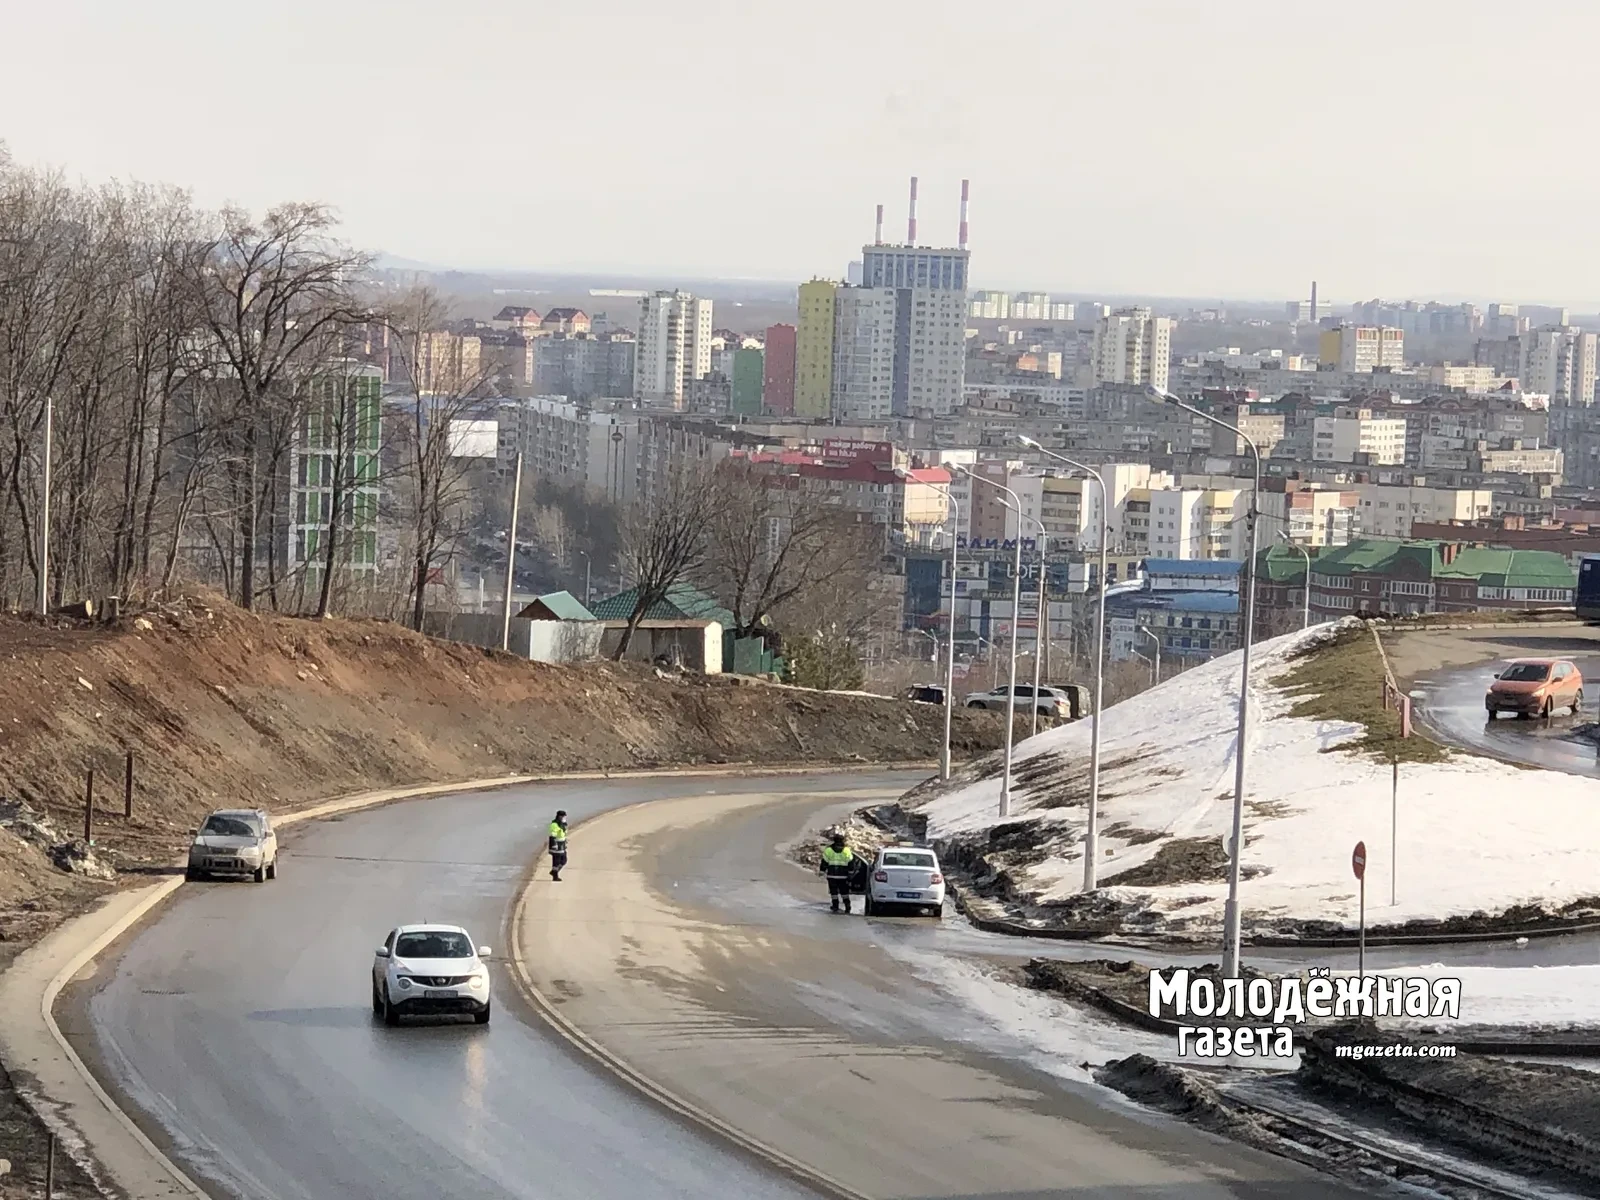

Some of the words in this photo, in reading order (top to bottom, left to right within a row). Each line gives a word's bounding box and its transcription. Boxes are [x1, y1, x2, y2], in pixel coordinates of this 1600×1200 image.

[852, 441, 877, 451] работу
[839, 449, 857, 458] hh.ru
[1006, 563, 1050, 579] LOFT
